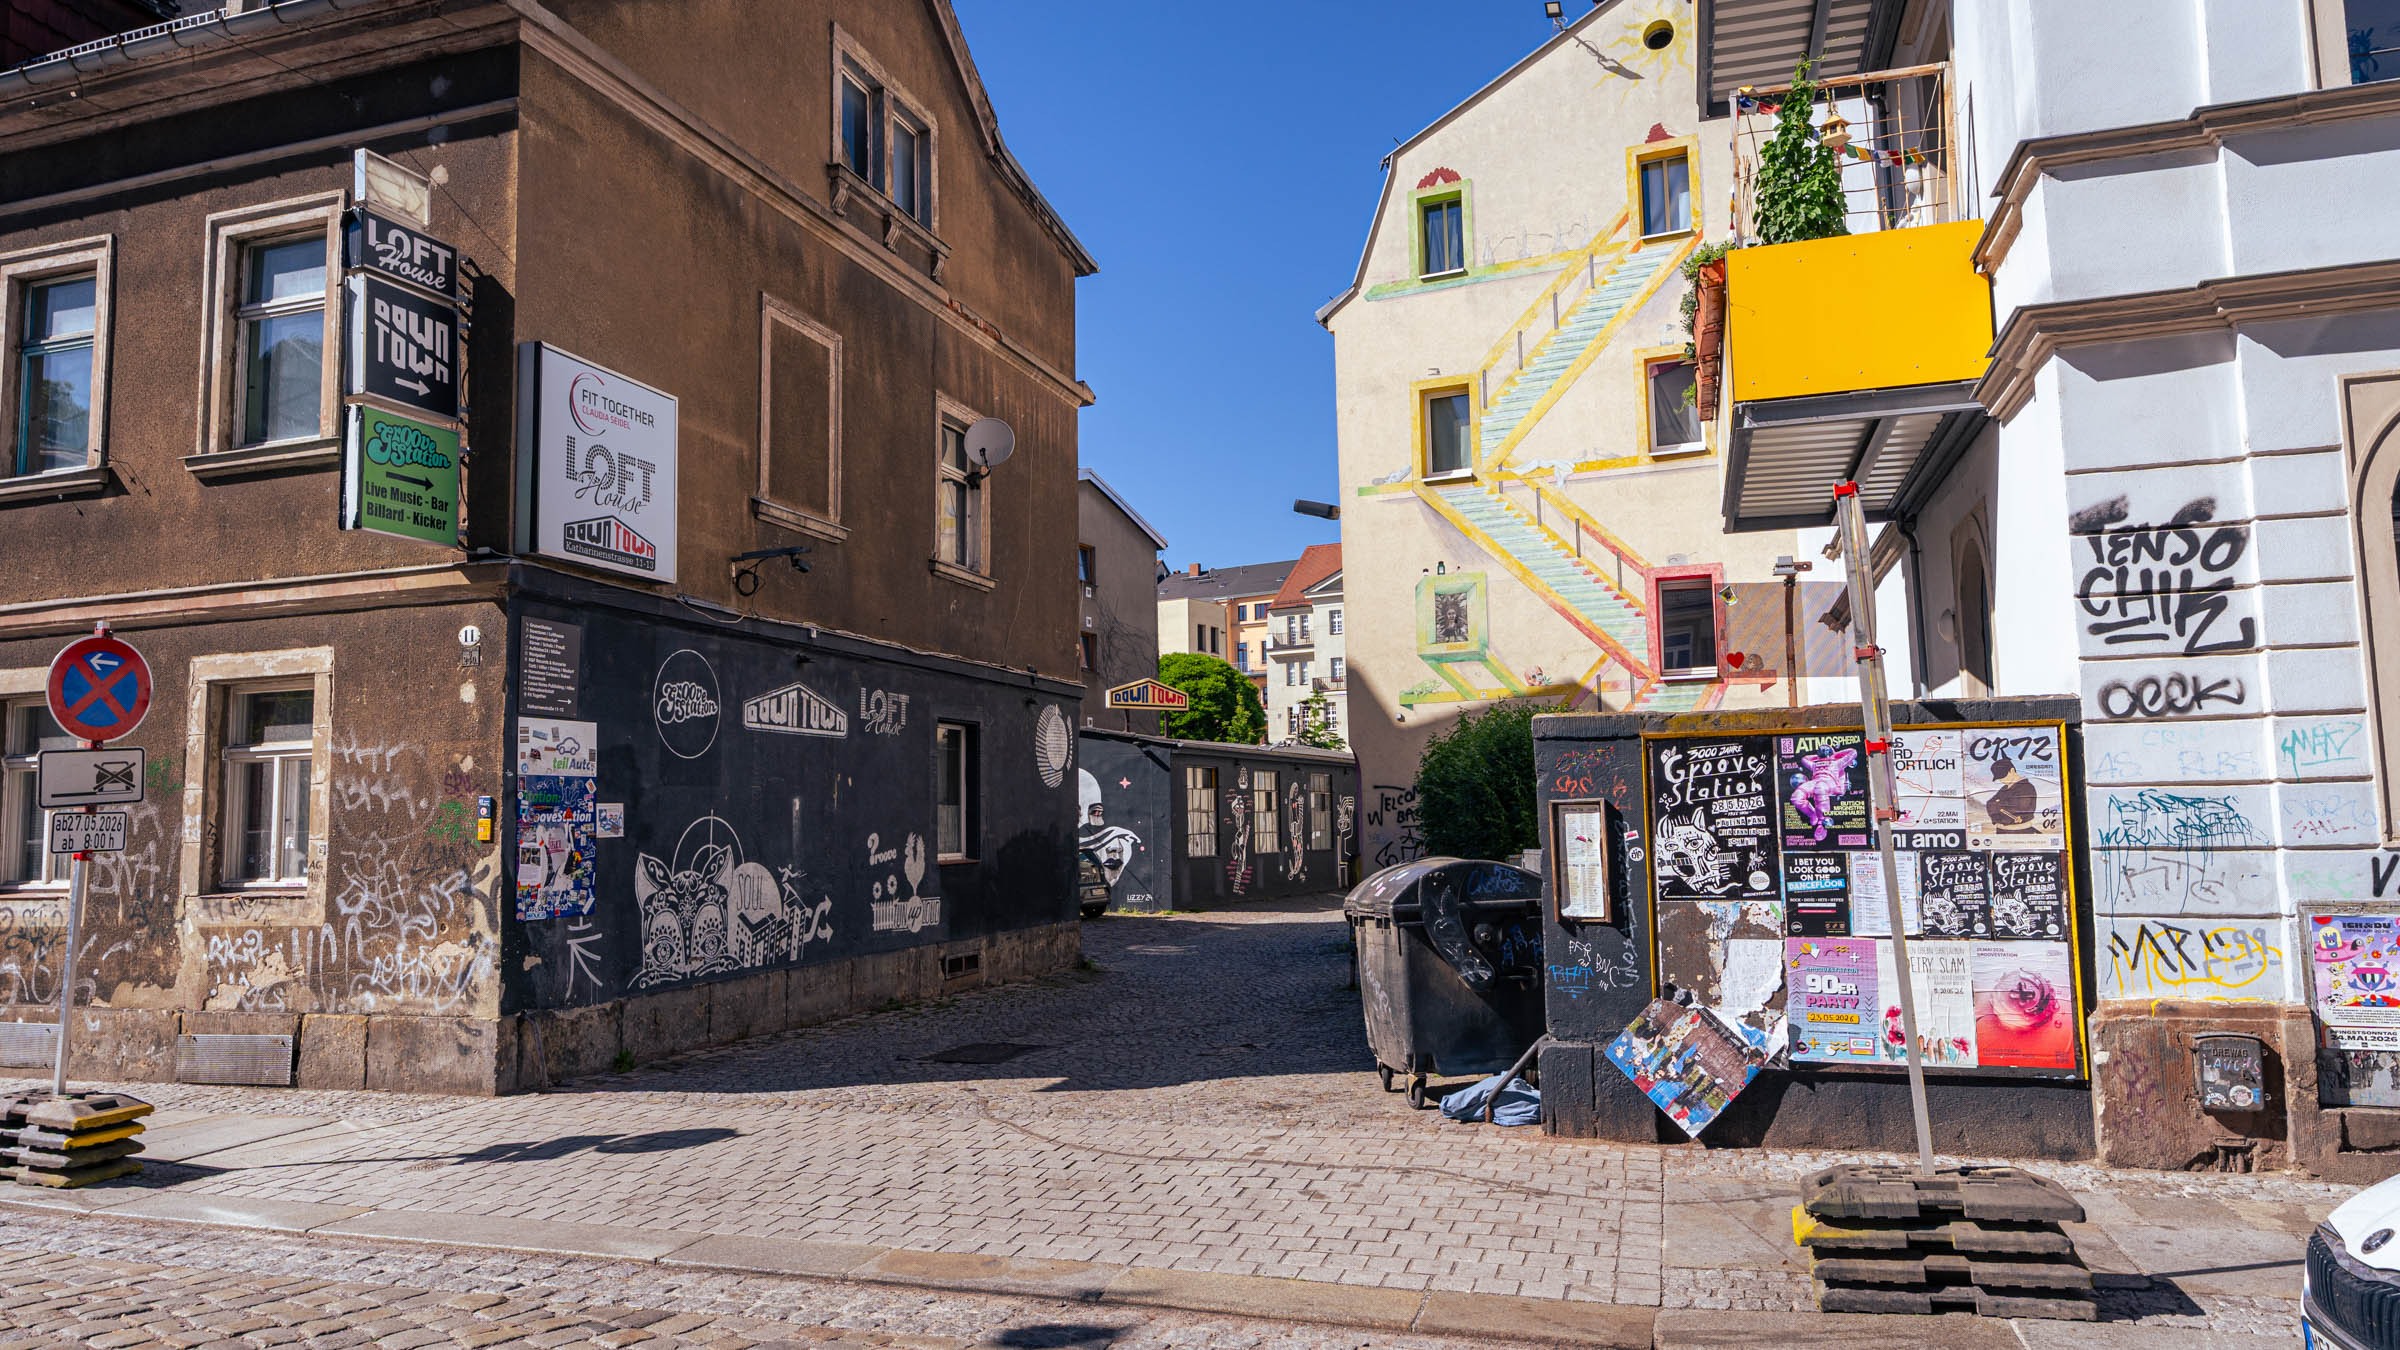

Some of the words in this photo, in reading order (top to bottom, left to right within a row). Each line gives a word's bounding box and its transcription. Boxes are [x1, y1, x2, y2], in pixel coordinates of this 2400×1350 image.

[368, 218, 452, 274] LOFT
[375, 242, 446, 290] House
[375, 297, 449, 364] DOWN
[375, 319, 449, 384] TOWN
[582, 389, 599, 403] FIT
[602, 396, 655, 429] TOGETHER
[582, 405, 610, 423] CLAUDIA
[610, 415, 631, 431] SEIDEL
[367, 421, 436, 465] Groove
[390, 441, 451, 469] Station
[566, 435, 656, 503] LOFT
[365, 481, 387, 499] Live
[390, 486, 423, 507] Music
[431, 495, 449, 513] Bar
[575, 470, 648, 515] House
[366, 501, 405, 522] Billard
[412, 511, 447, 531] Kicker
[566, 519, 654, 558] DOWNTOWN
[565, 541, 634, 566] Katharinenstrasse
[635, 557, 655, 570] 11-13
[464, 629, 475, 643] 11
[658, 682, 707, 724] Groove
[861, 688, 909, 726] LOFT
[1115, 684, 1183, 705] DOWNTOWN
[674, 699, 718, 723] Station
[747, 690, 844, 732] DOWNTOWN
[865, 710, 905, 738] House
[1687, 748, 1717, 761] 3000
[1719, 745, 1743, 757] JAHRE
[1895, 759, 1955, 771] ORTLICH
[1664, 754, 1760, 784] Groove
[1670, 777, 1763, 807] Station
[1713, 798, 1763, 812] 28.5.2026
[62, 834, 74, 850] ab
[84, 833, 106, 848] 8:00
[109, 833, 114, 848] h
[1912, 833, 1960, 848] amo
[1789, 866, 1814, 874] LOOK
[1815, 866, 1841, 874] GOOD
[1799, 857, 1813, 866] BET
[1815, 857, 1834, 866] YOU
[1927, 859, 1981, 876] Groove
[1998, 859, 2053, 876] Groove
[737, 873, 764, 911] SOUL
[1789, 880, 1843, 890] DANCEFLOOR
[1931, 873, 1982, 888] Station
[2000, 874, 2054, 888] Station
[1911, 957, 1934, 973] ETRY
[1940, 957, 1966, 974] SLAM
[1806, 974, 1858, 995] 90ER
[1806, 995, 1860, 1009] PARTY
